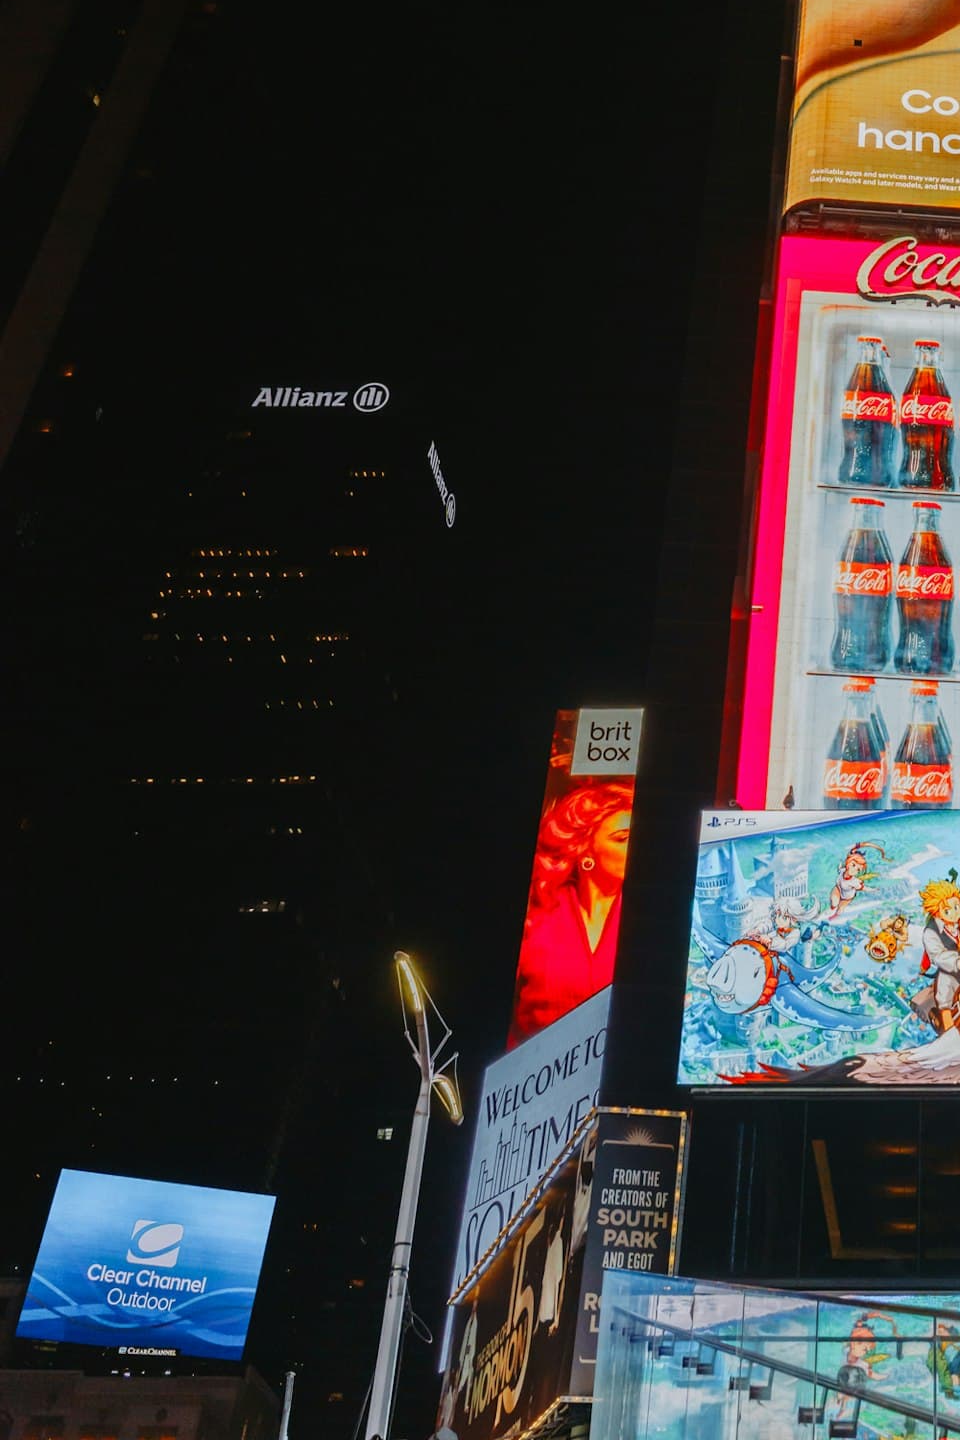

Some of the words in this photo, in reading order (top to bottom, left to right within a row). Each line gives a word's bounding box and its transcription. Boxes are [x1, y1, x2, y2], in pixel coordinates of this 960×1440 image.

[251, 387, 349, 408] Allianz
[427, 440, 449, 506] Allianz
[590, 721, 632, 741] brit
[587, 741, 632, 762] box
[724, 817, 757, 826] PS5
[486, 1044, 580, 1129] WELCOME
[612, 1168, 642, 1187] FROM
[642, 1170, 661, 1188] THE
[601, 1188, 653, 1208] CREATORS
[656, 1192, 669, 1209] OF
[596, 1208, 669, 1230] SOUTH
[603, 1228, 660, 1249] PARK
[602, 1251, 624, 1269] AND
[627, 1252, 655, 1272] EGOT
[86, 1263, 135, 1286] Clear
[135, 1268, 208, 1295] Channel
[106, 1287, 177, 1312] Outdoor
[468, 1318, 529, 1426] MORMON
